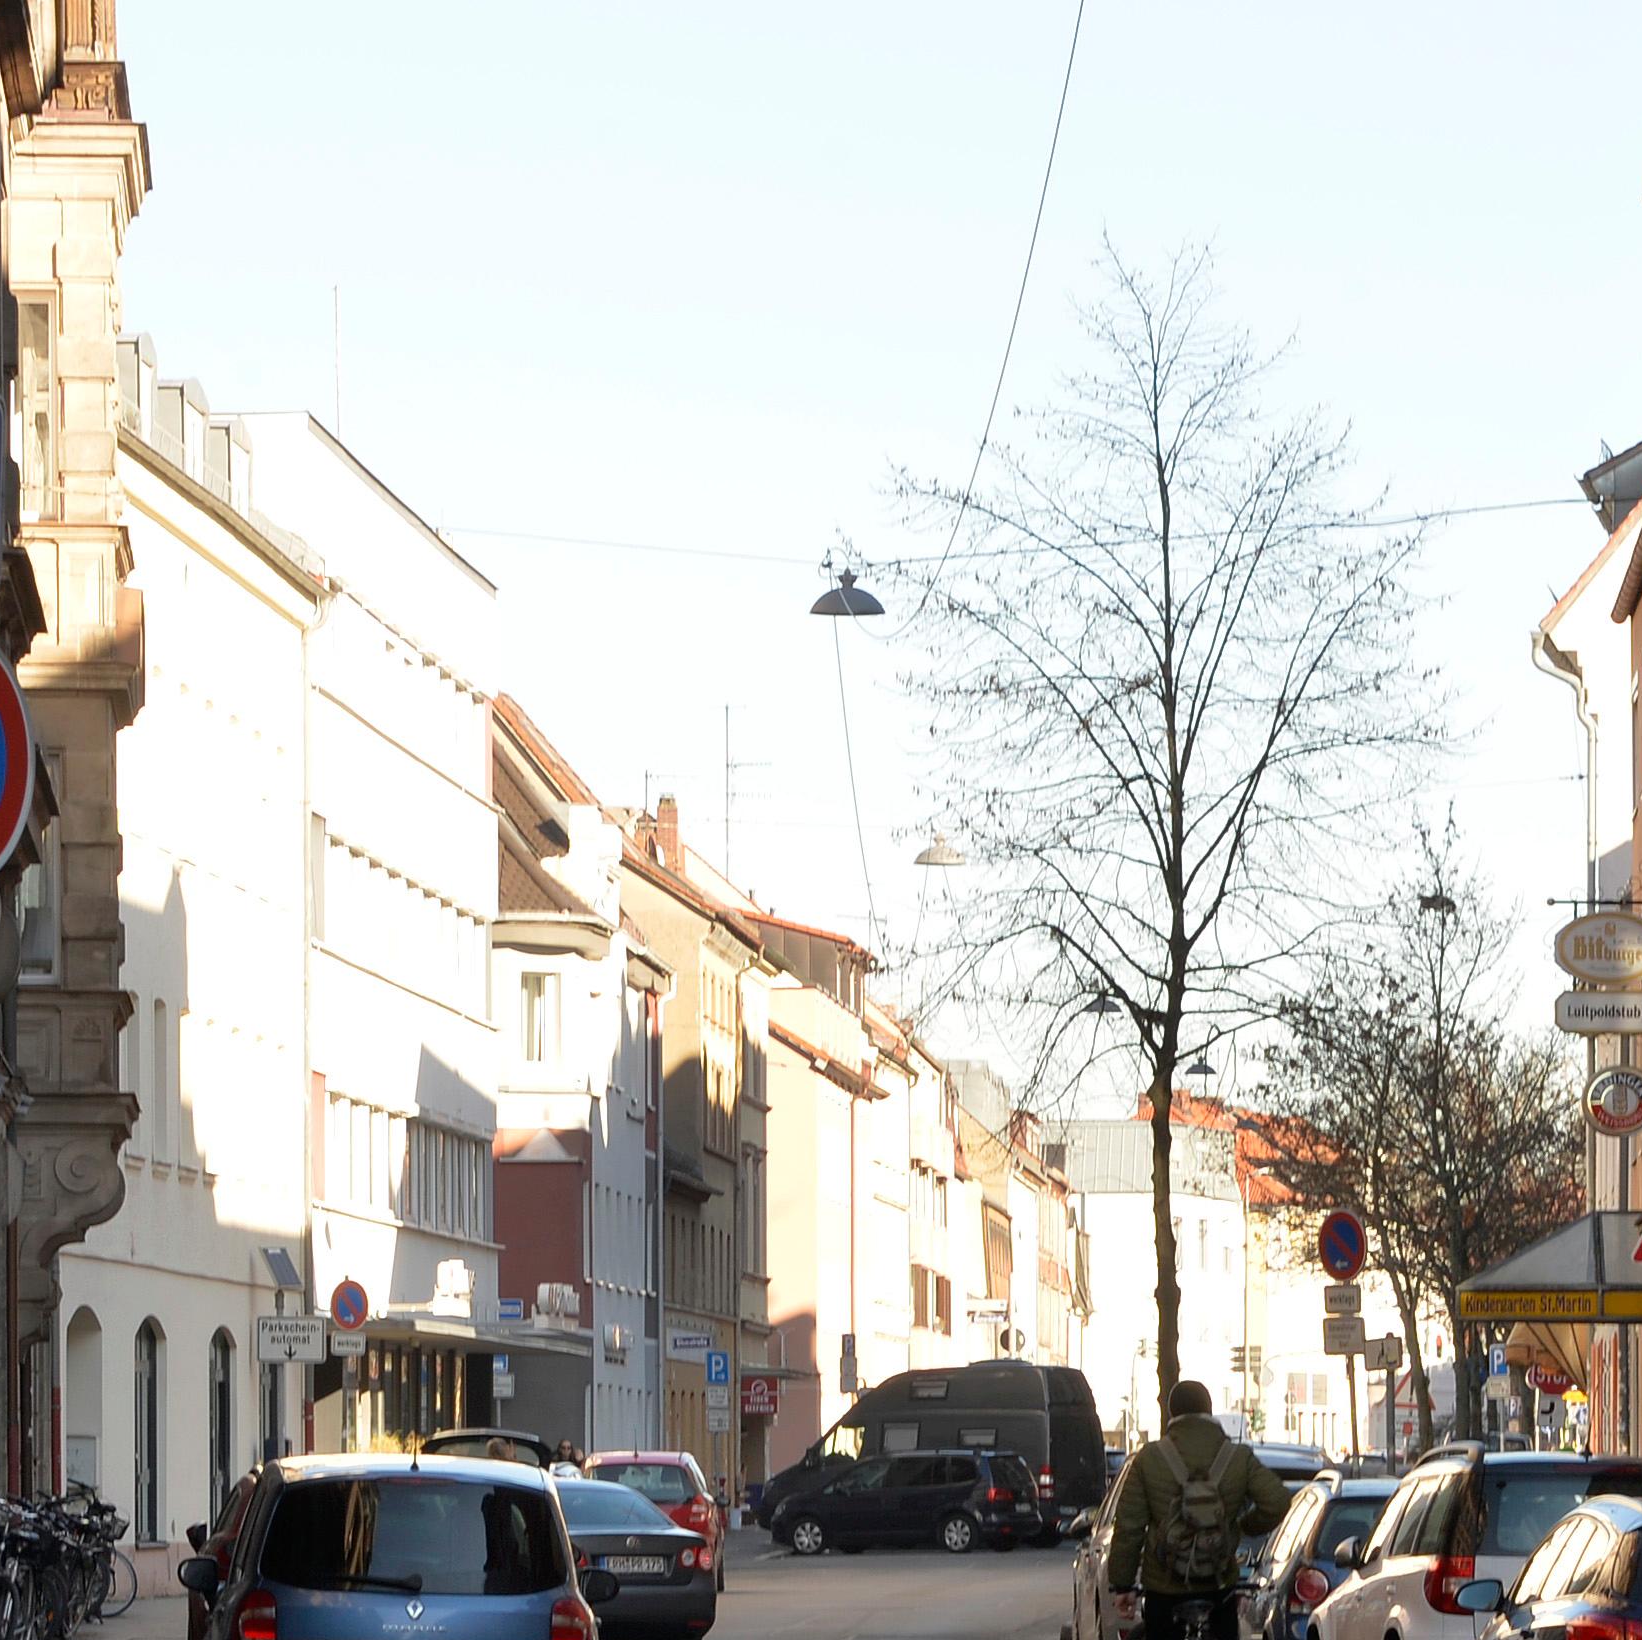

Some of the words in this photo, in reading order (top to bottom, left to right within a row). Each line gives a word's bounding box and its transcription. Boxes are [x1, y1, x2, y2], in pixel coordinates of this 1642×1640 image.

[1465, 1296, 1536, 1314] Kindergarten
[261, 1322, 320, 1333] Parkschein-
[270, 1335, 311, 1345] automat
[711, 1355, 724, 1380] P
[1493, 1349, 1504, 1375] P
